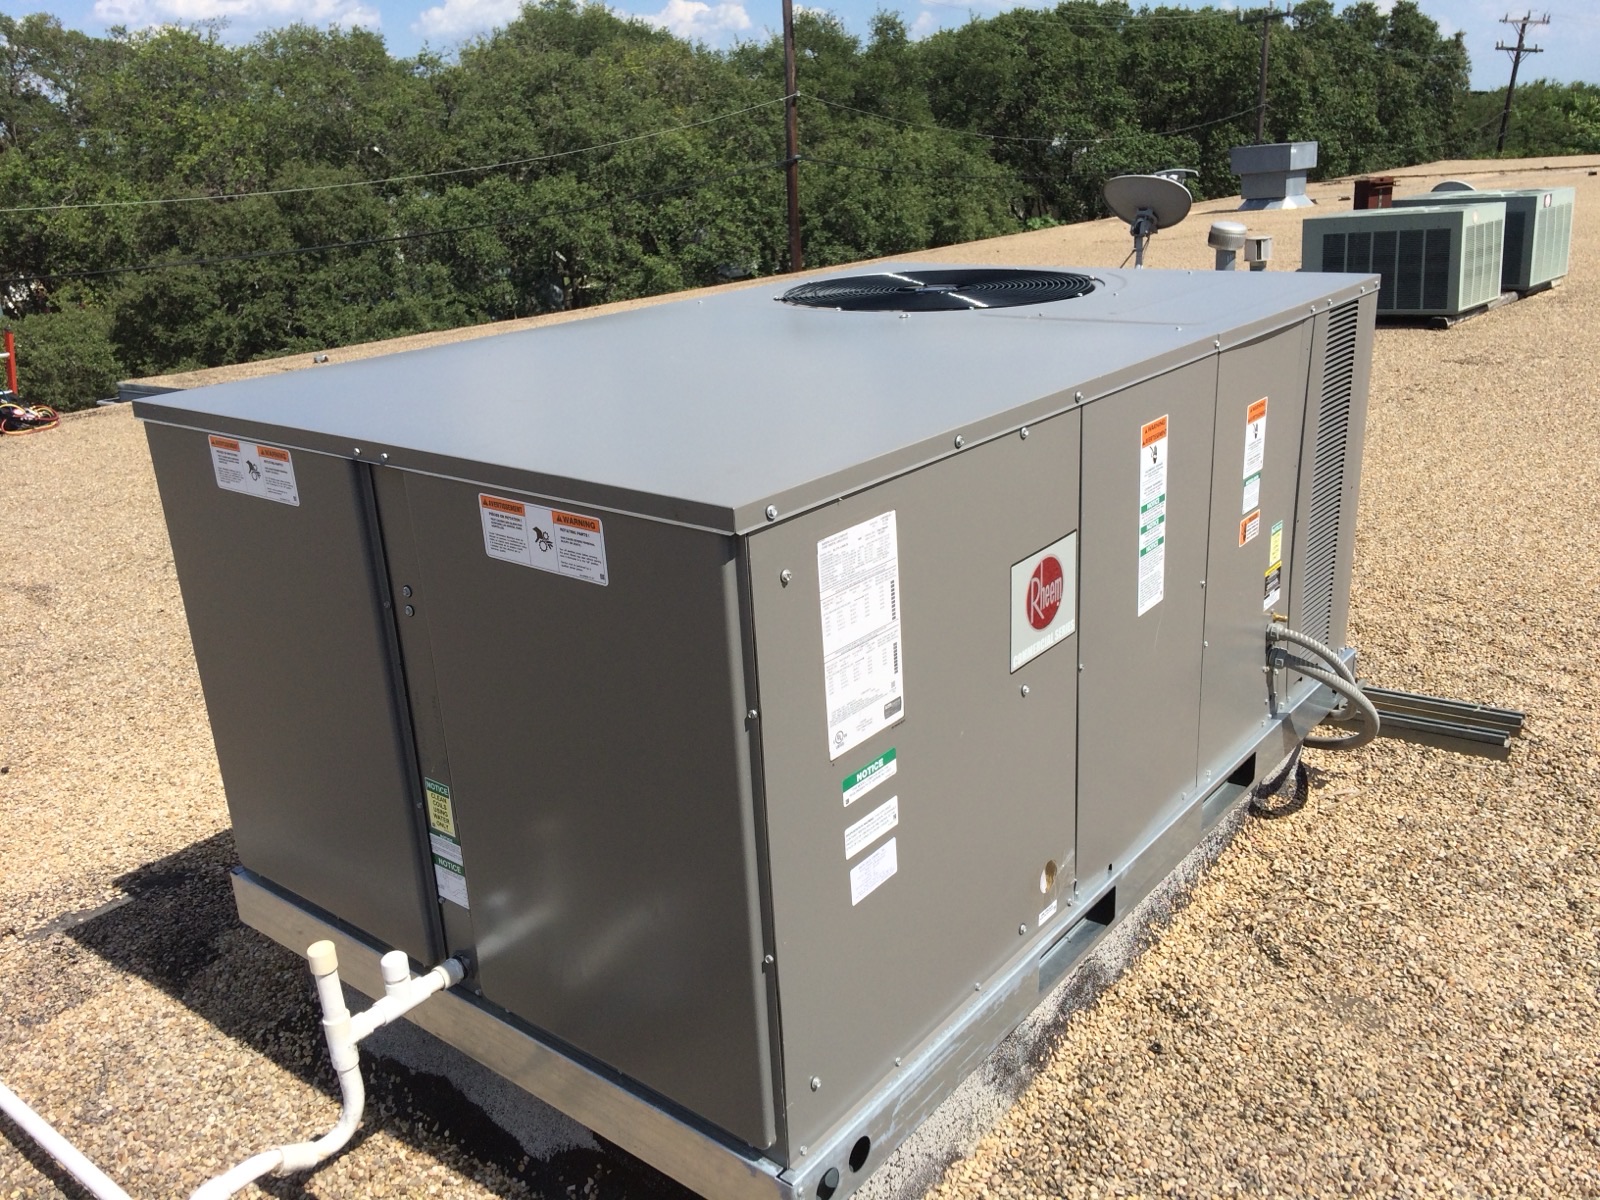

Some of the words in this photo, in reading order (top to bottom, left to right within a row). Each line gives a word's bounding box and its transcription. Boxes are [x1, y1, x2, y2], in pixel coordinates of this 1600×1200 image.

[1148, 418, 1166, 432] WARNING
[488, 500, 523, 513] AVERTISSEMENT
[563, 516, 596, 530] WARNING
[1030, 560, 1063, 625] Rheem
[1012, 632, 1054, 669] COMMERCIAL
[1054, 619, 1075, 642] SERIES
[856, 757, 884, 783] NOTICE
[426, 782, 449, 796] NOTICE
[431, 793, 447, 804] CLEAN
[433, 800, 447, 810] COILS
[433, 807, 448, 818] USING
[433, 813, 450, 824] WATER
[436, 821, 449, 830] ONLY
[439, 858, 462, 874] NOTICE
